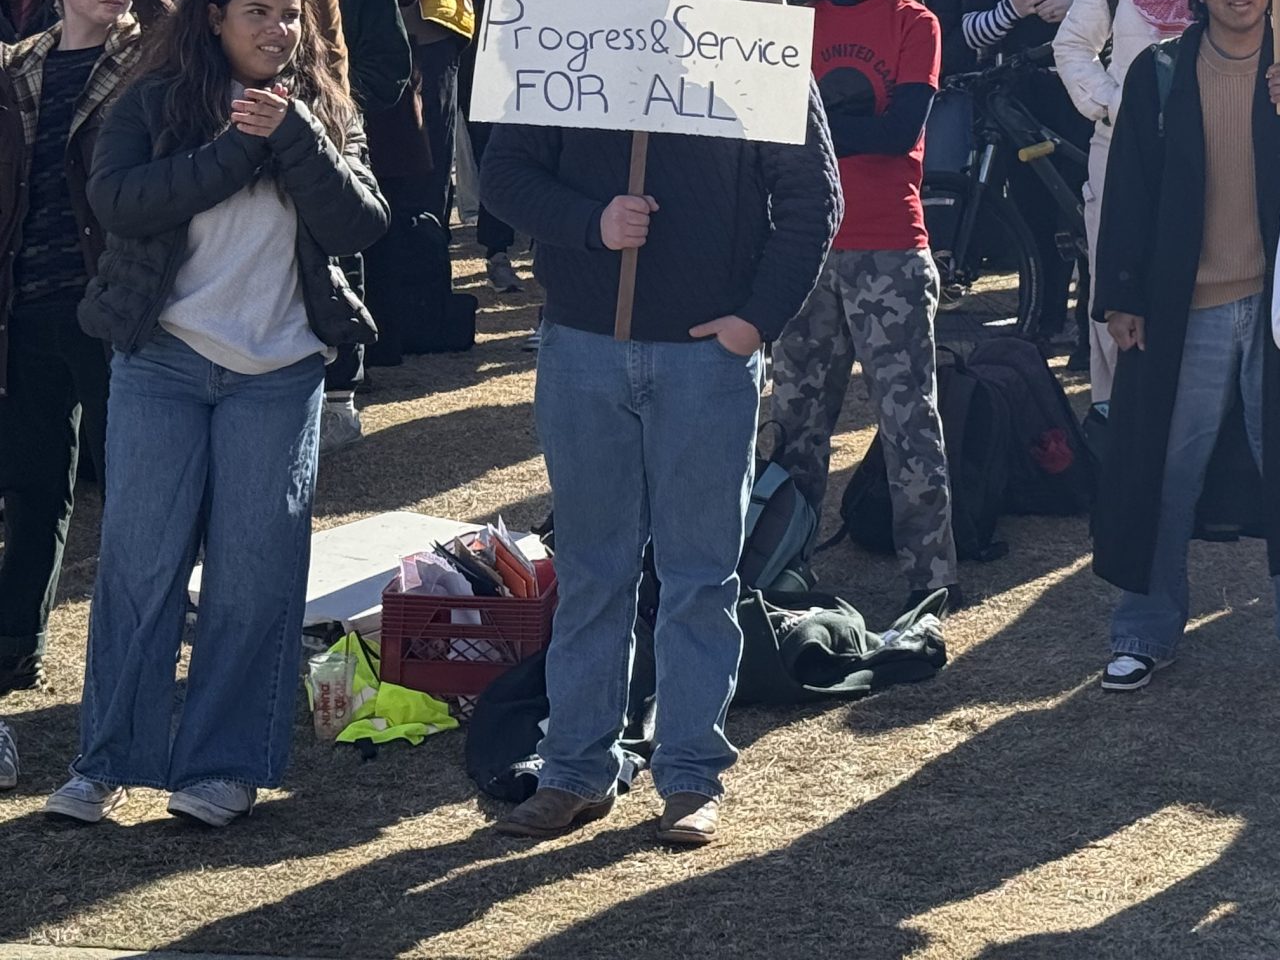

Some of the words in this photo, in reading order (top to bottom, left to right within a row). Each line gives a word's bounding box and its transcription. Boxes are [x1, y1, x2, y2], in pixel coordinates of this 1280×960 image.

[821, 44, 875, 63] UNITED
[515, 69, 609, 113] FOR
[643, 74, 737, 121] ALL
